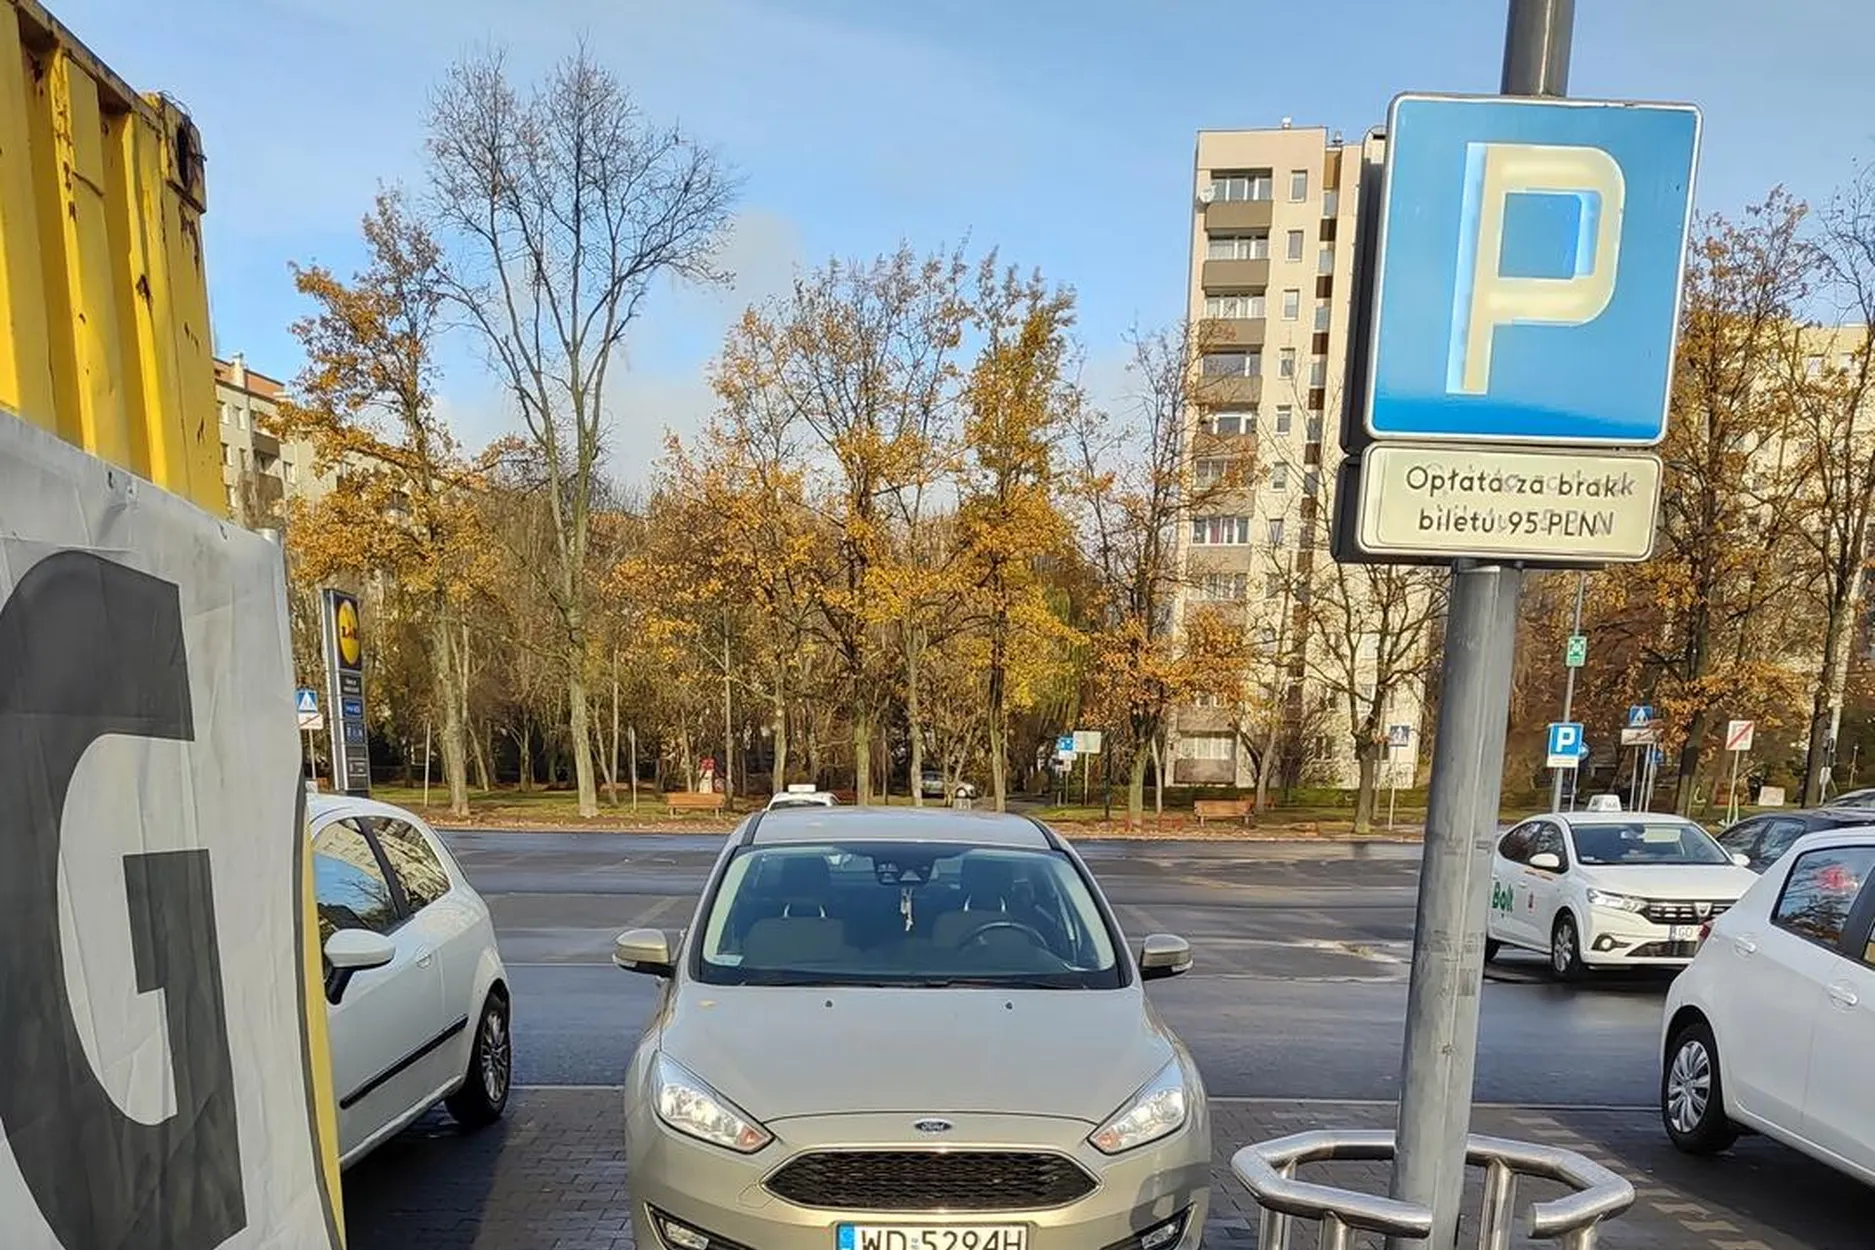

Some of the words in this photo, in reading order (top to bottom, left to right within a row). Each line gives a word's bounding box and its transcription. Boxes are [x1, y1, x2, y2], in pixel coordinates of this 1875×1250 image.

[1446, 141, 1626, 397] P
[1508, 511, 1539, 535] 95
[1556, 727, 1575, 752] P
